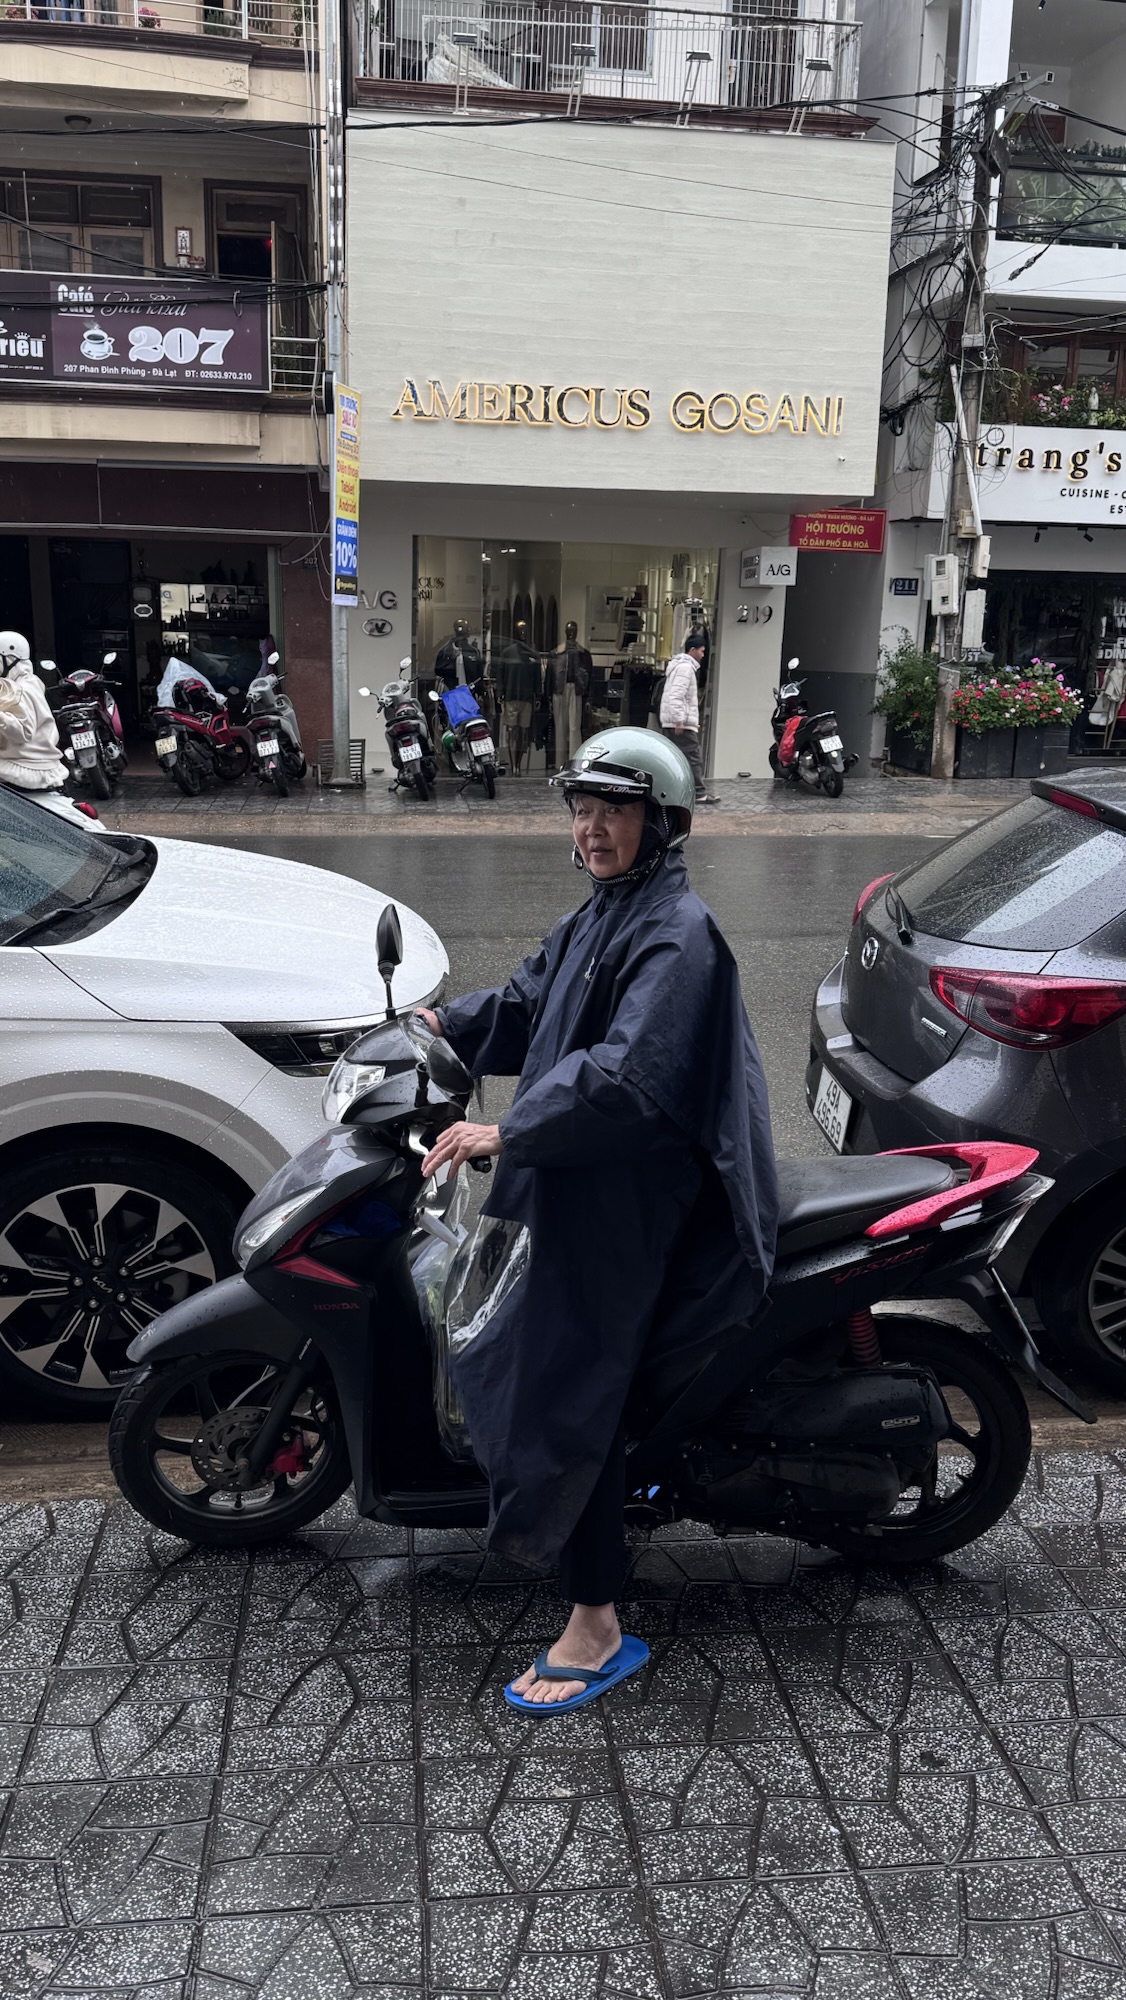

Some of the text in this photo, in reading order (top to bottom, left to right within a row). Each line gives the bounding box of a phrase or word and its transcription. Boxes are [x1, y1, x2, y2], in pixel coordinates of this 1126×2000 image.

[58, 284, 95, 314] Café
[128, 325, 234, 365] 207
[64, 364, 77, 373] 207
[80, 364, 99, 374] Phan
[391, 377, 844, 437] AMERICUS GOSANI
[976, 441, 1123, 480] trang's
[341, 480, 355, 496] Tablet
[1060, 488, 1110, 498] CUISINE
[338, 497, 357, 514] Android
[806, 521, 865, 536] HỘI TRƯỜNG
[336, 541, 358, 569] 10%
[766, 564, 791, 576] A/G
[895, 579, 916, 591] 211
[736, 604, 773, 624] 219
[312, 1302, 361, 1311] HONDA
